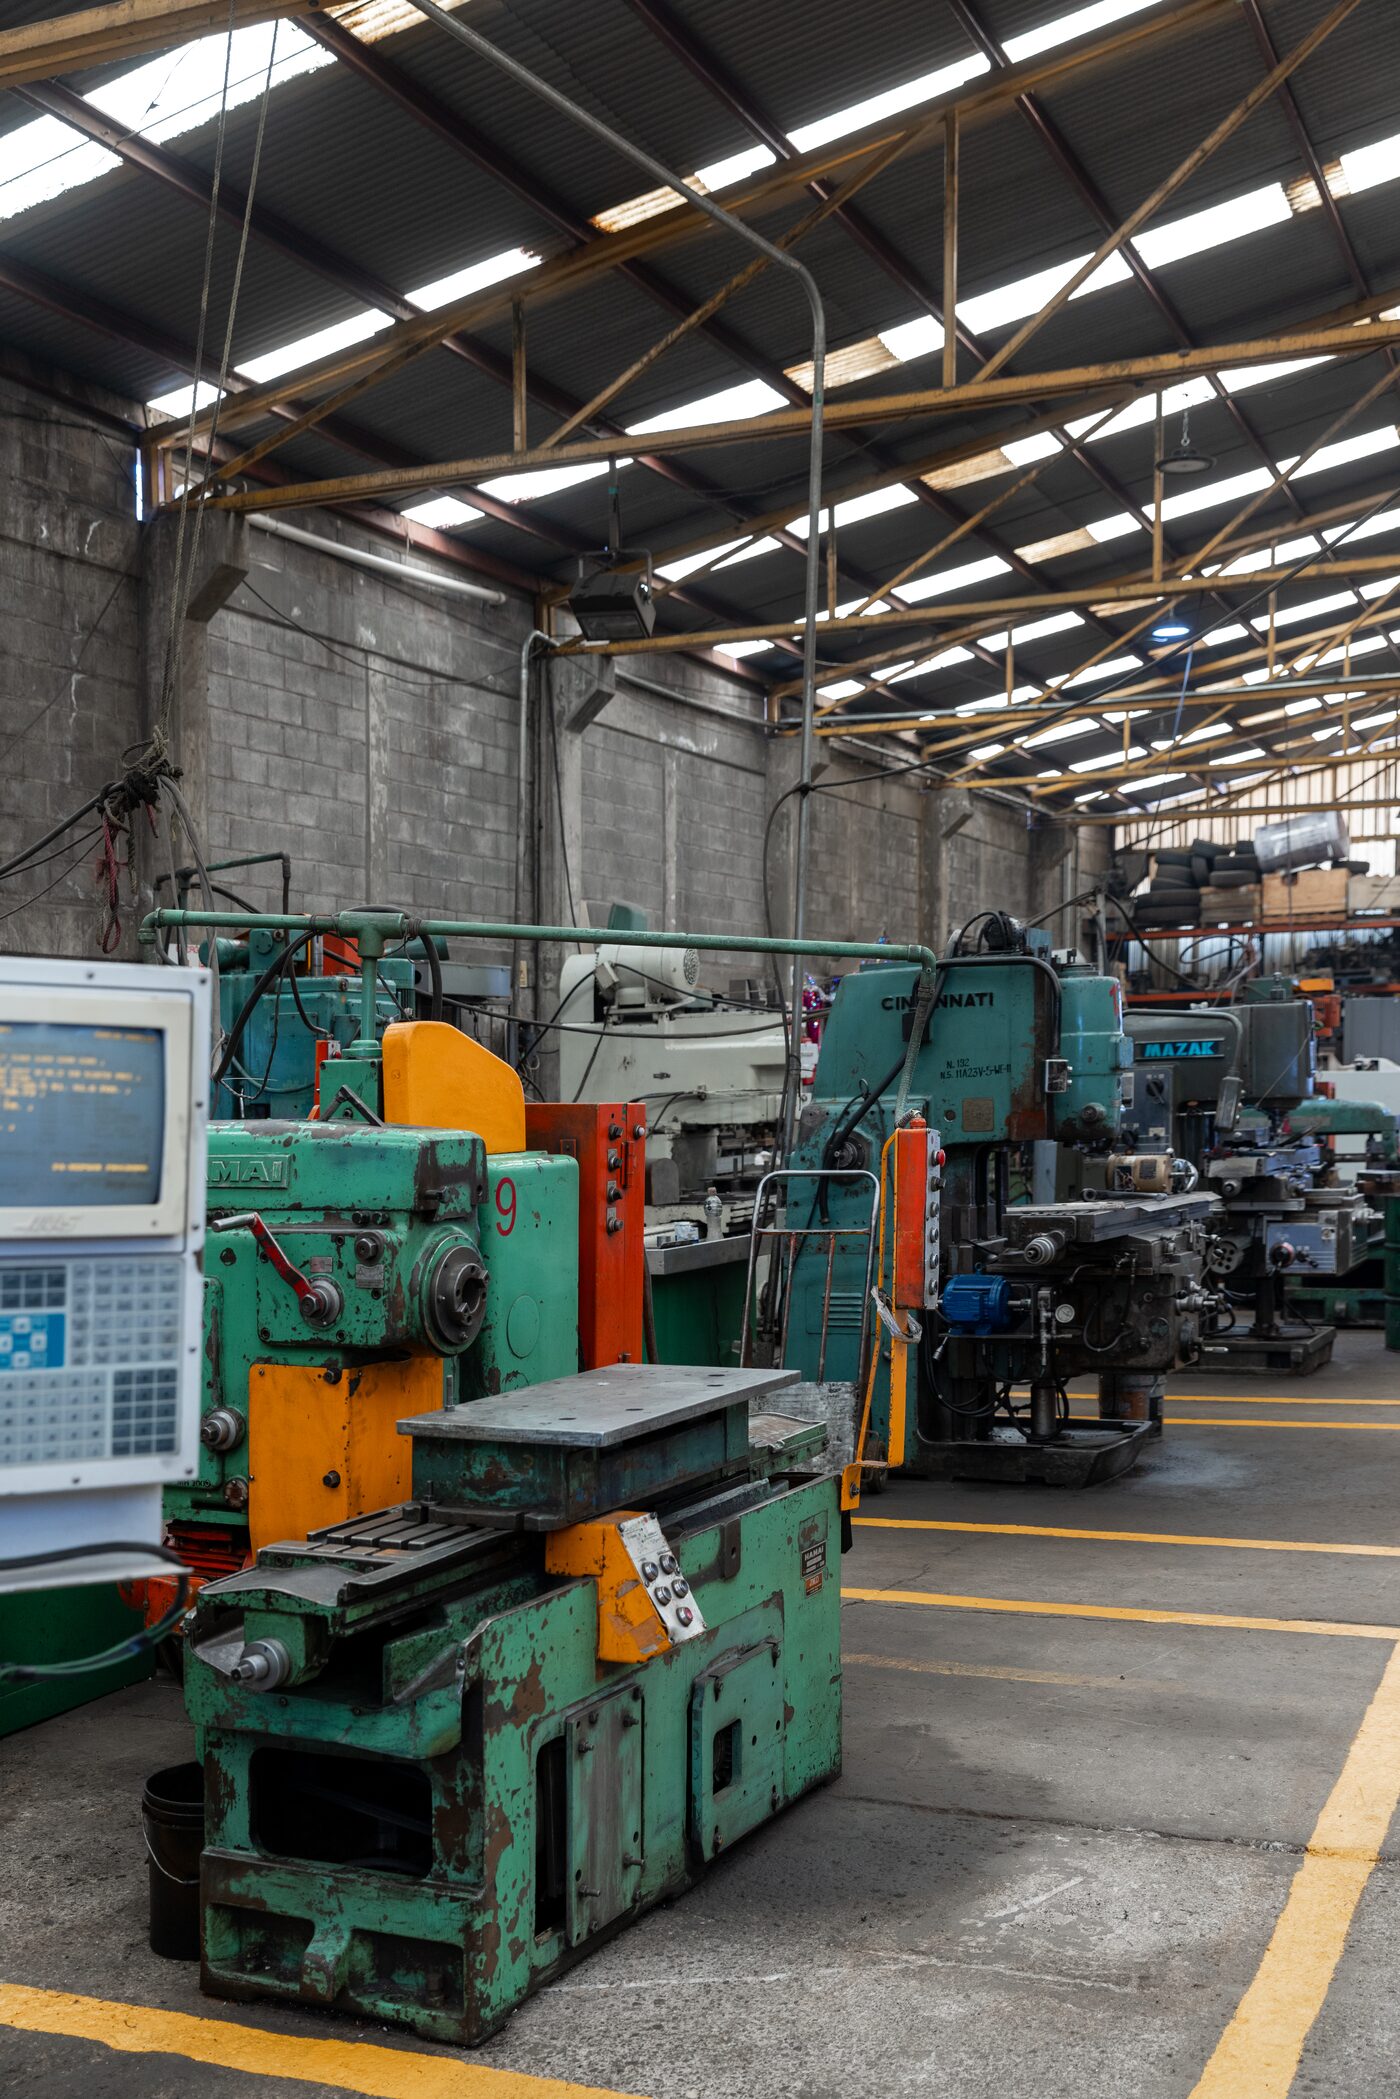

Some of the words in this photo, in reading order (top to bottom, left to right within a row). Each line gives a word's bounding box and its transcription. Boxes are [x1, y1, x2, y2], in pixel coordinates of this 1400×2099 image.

[881, 992, 994, 1011] CINNNATI
[1143, 1041, 1216, 1057] MAZAK
[495, 1177, 517, 1236] 9
